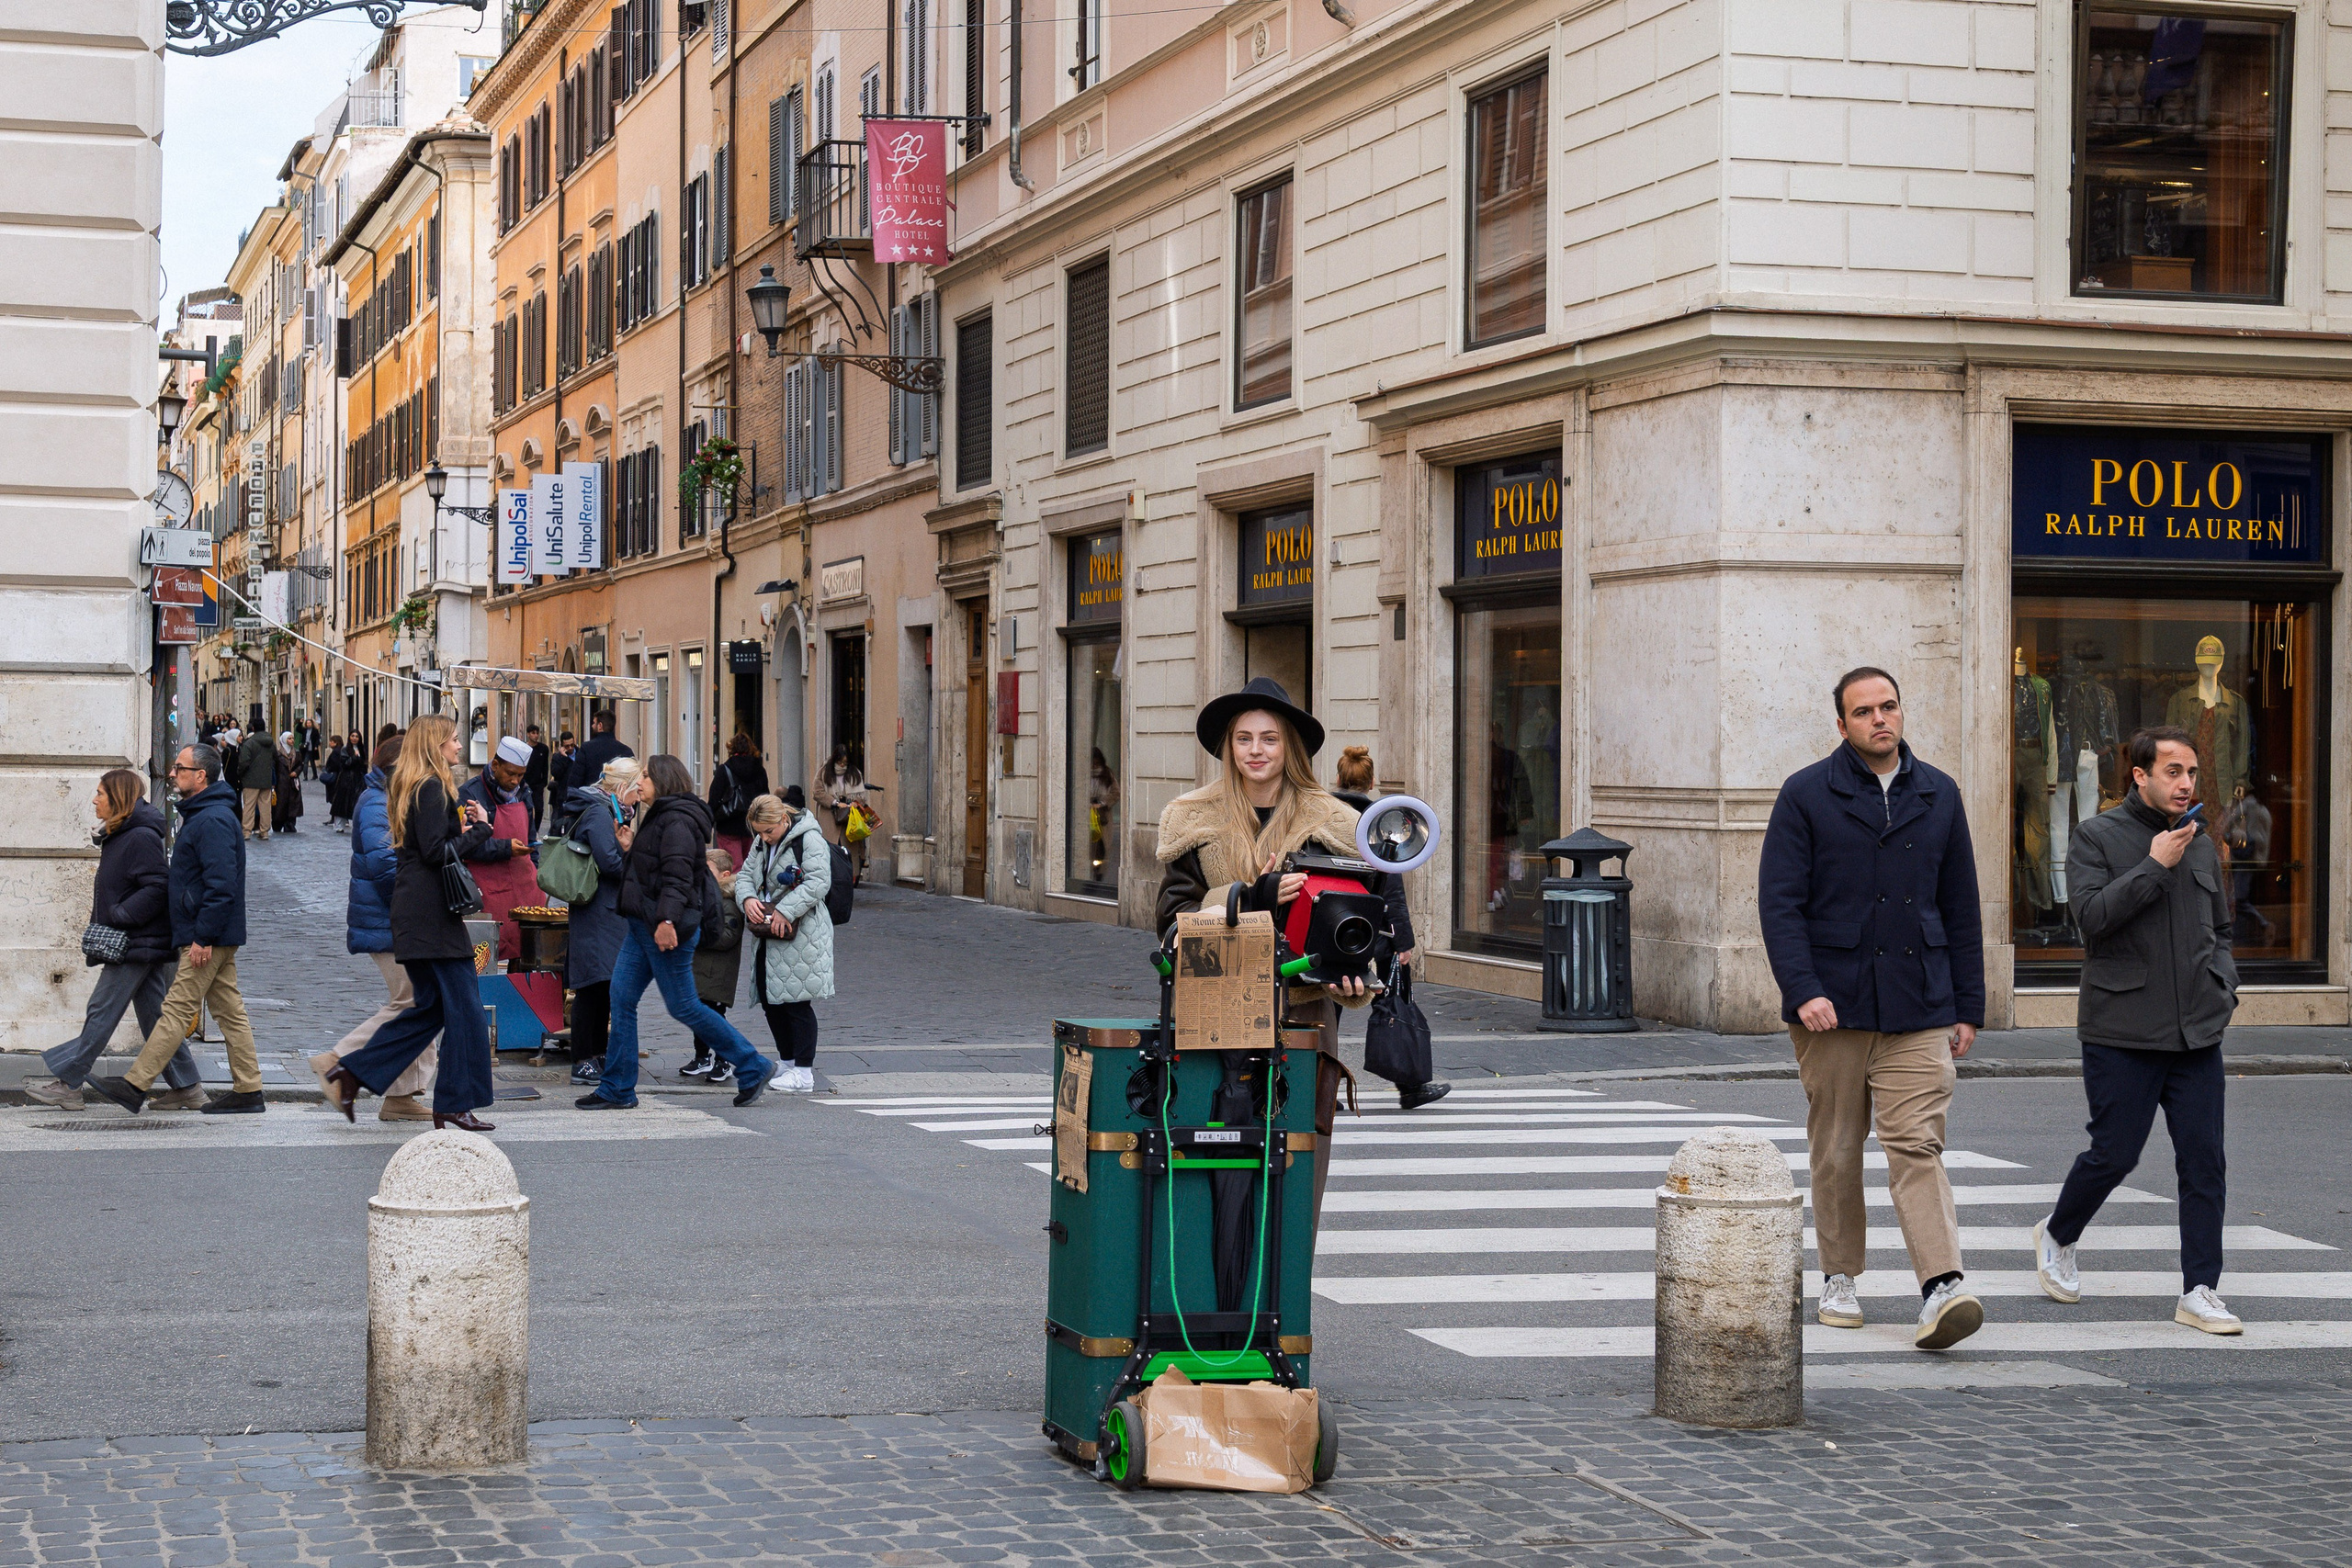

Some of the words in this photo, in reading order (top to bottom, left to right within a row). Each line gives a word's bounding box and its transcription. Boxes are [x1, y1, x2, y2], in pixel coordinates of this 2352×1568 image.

[876, 183, 942, 194] BOUTIQUE
[876, 194, 943, 206] CENTRALE
[875, 205, 944, 231] Palace
[894, 230, 930, 241] HOTEL
[2090, 458, 2243, 510] POLO
[182, 499, 189, 509] 3
[1493, 478, 1558, 529] POLO
[248, 442, 266, 614] PROFUMERIA
[546, 482, 563, 566] UniSalute
[578, 476, 596, 563] UnipolRental
[2045, 513, 2146, 537] RALPH
[2165, 517, 2285, 542] LAUREN
[198, 536, 210, 547] piazza
[508, 493, 532, 574] UnipolSai
[1265, 524, 1313, 566] POLO
[1476, 536, 1517, 558] RALPH
[1524, 529, 1563, 553] LAUR
[196, 548, 211, 559] popolo
[1089, 550, 1123, 585] POLO
[1253, 570, 1283, 590] RALPH
[175, 579, 187, 592] Piazza
[188, 580, 203, 592] Navona
[823, 568, 861, 596] CASTRONI
[1080, 590, 1102, 606] RALPH
[1191, 917, 1216, 927] Rome
